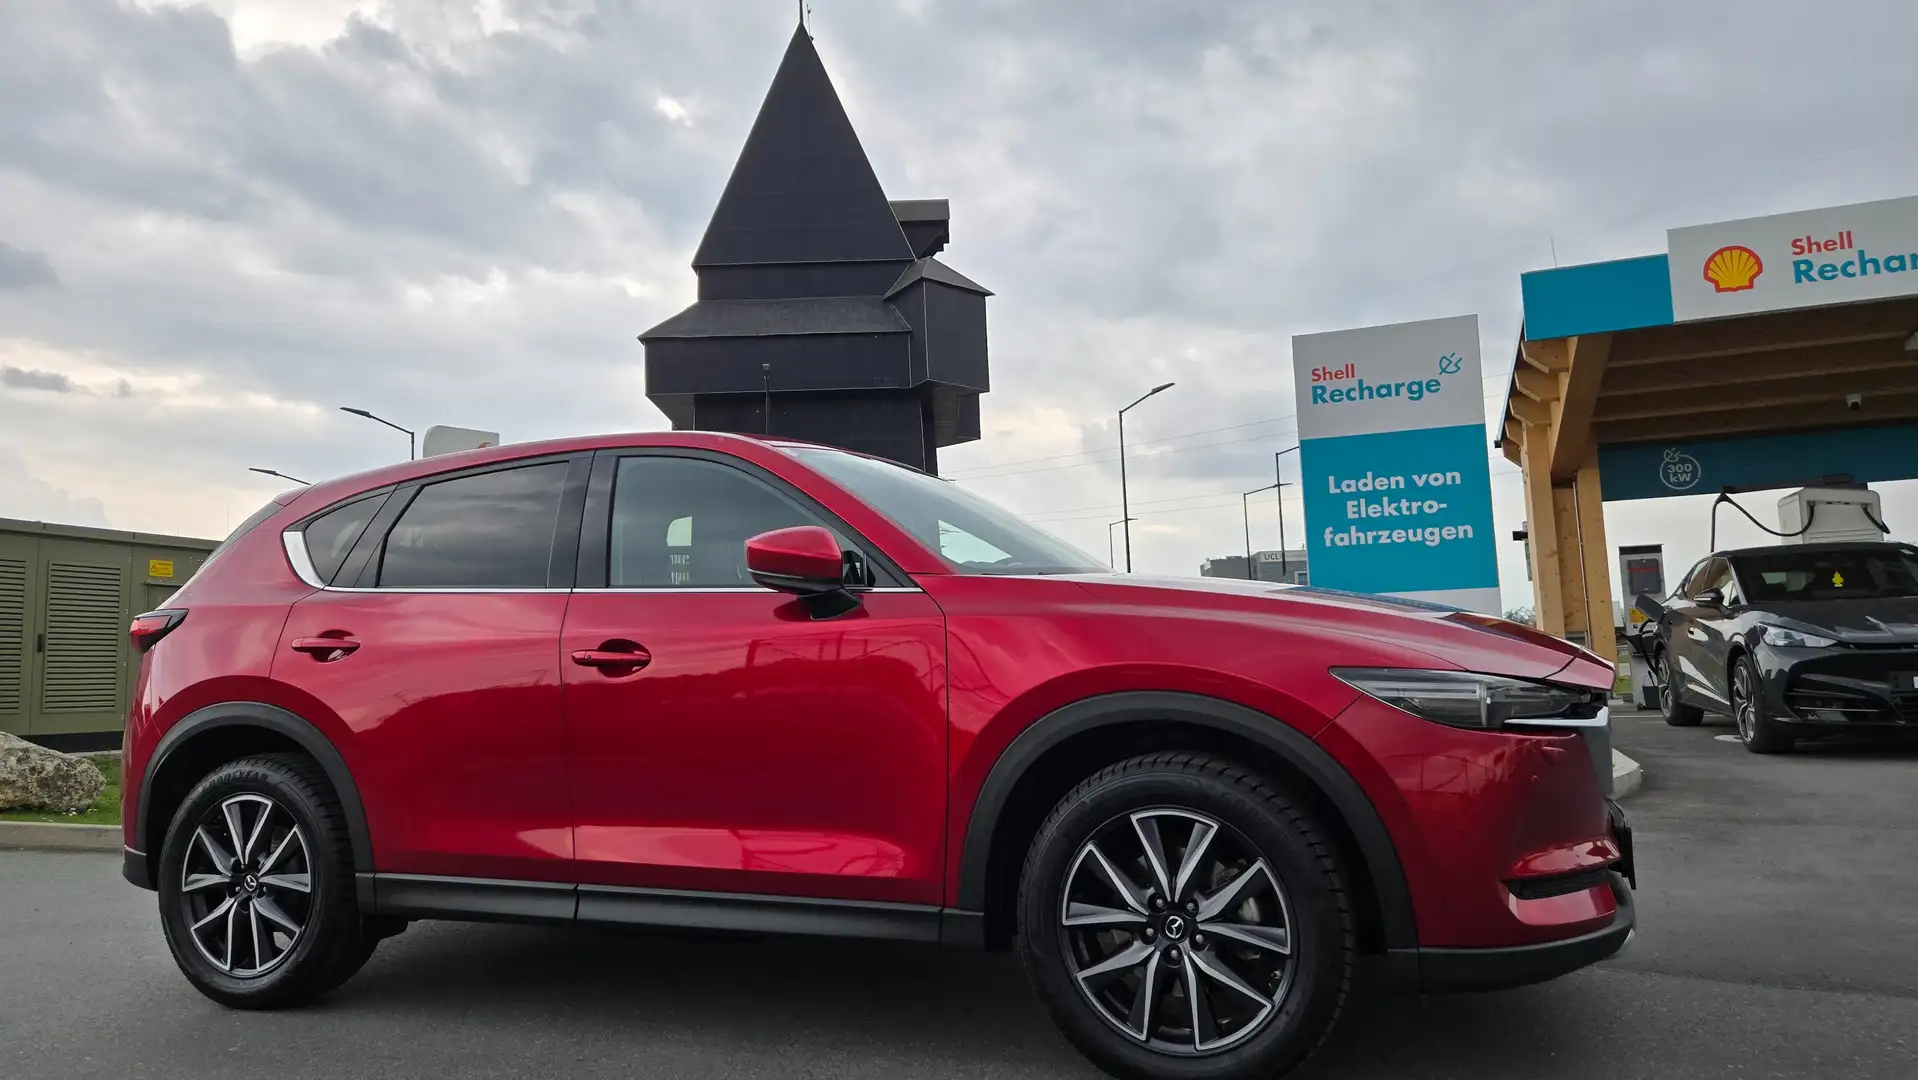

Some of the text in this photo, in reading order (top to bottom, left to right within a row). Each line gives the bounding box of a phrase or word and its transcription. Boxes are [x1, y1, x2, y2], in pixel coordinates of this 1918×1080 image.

[1791, 231, 1853, 256] Shell
[1311, 363, 1355, 383] Shell
[1311, 378, 1441, 405] Recharge
[1667, 463, 1693, 473] 300
[1670, 473, 1692, 483] kW
[1328, 471, 1461, 494] Laden von
[1346, 496, 1447, 519] Elektro-
[1323, 524, 1473, 548] fahrzeugen
